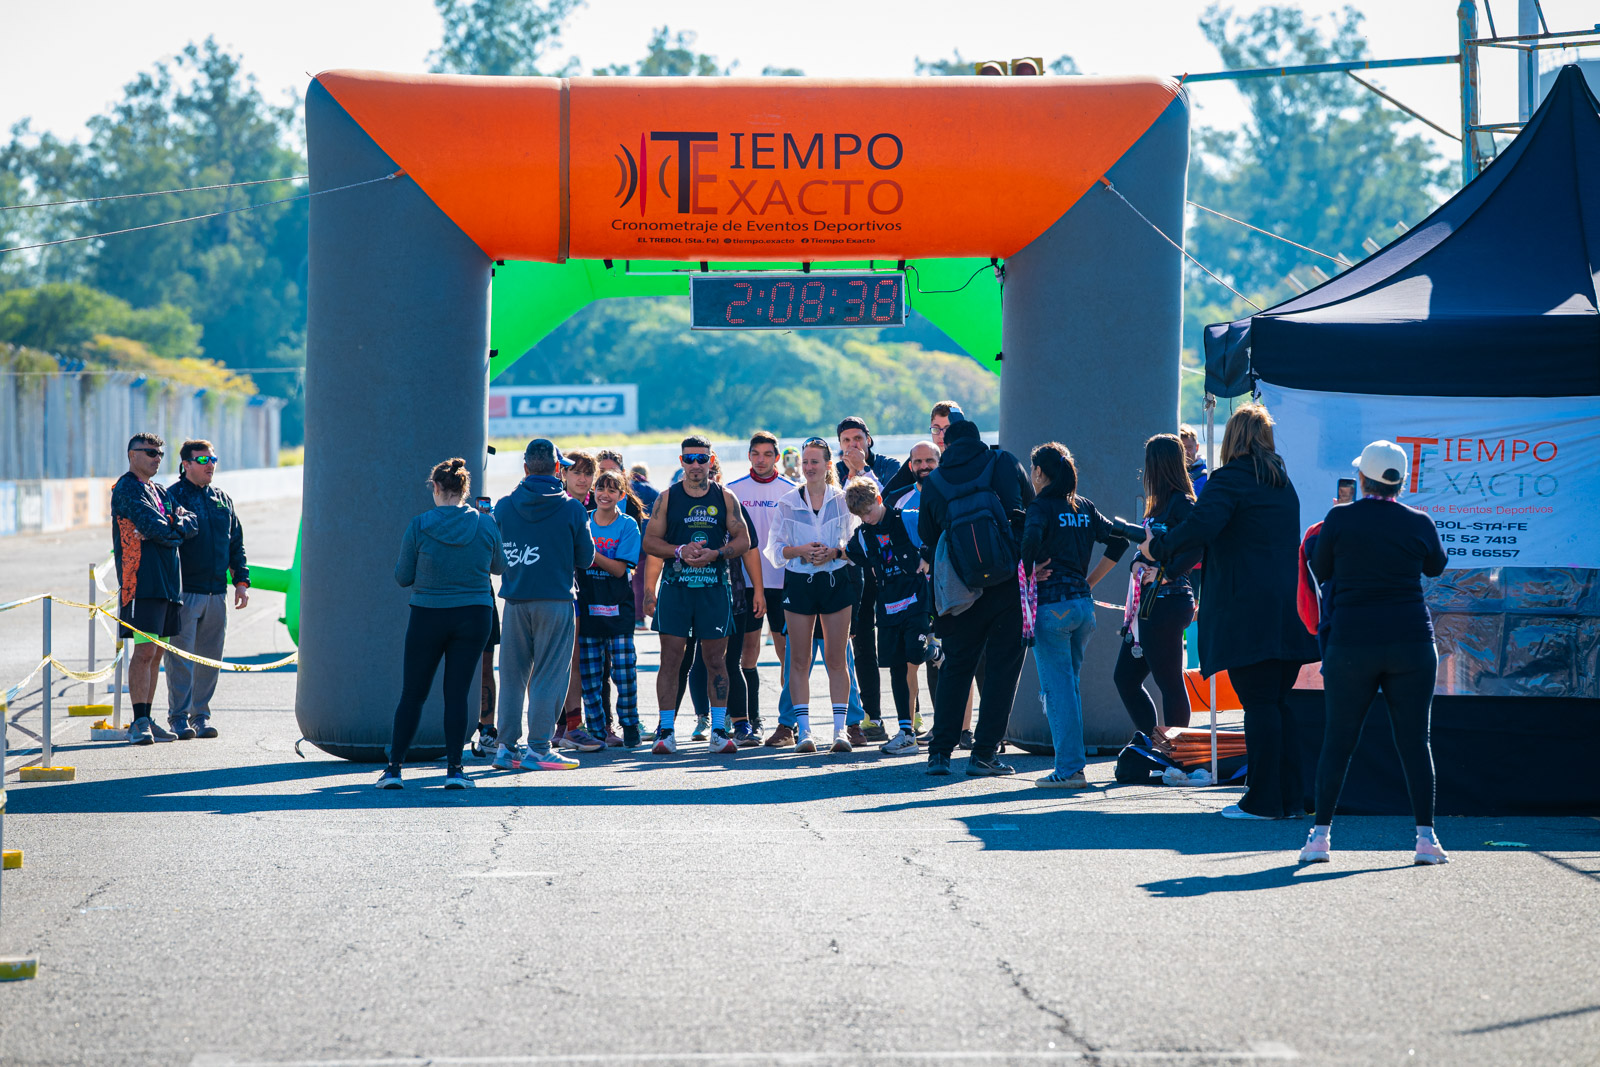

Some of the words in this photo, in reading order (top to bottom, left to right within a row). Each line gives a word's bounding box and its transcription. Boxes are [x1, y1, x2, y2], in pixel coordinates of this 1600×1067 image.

[650, 131, 904, 214] TIEMPO
[692, 143, 904, 215] EXACTO
[611, 219, 718, 233] Cronometraje
[722, 220, 742, 231] de
[747, 220, 809, 231] Eventos
[814, 220, 902, 233] Deportivos
[706, 237, 719, 245] Fe)
[726, 280, 898, 324] 2:08:38
[1396, 436, 1558, 494] TIEMPO
[1418, 447, 1559, 498] EXACTO
[1432, 504, 1446, 513] de
[1449, 505, 1493, 514] Eventos
[1496, 505, 1554, 516] Deportivos
[1058, 512, 1090, 528] STAFF
[1435, 520, 1528, 531] BOL-STA-FE
[1460, 535, 1480, 544] 52
[1484, 536, 1518, 544] 7413
[1472, 549, 1520, 558] 66557
